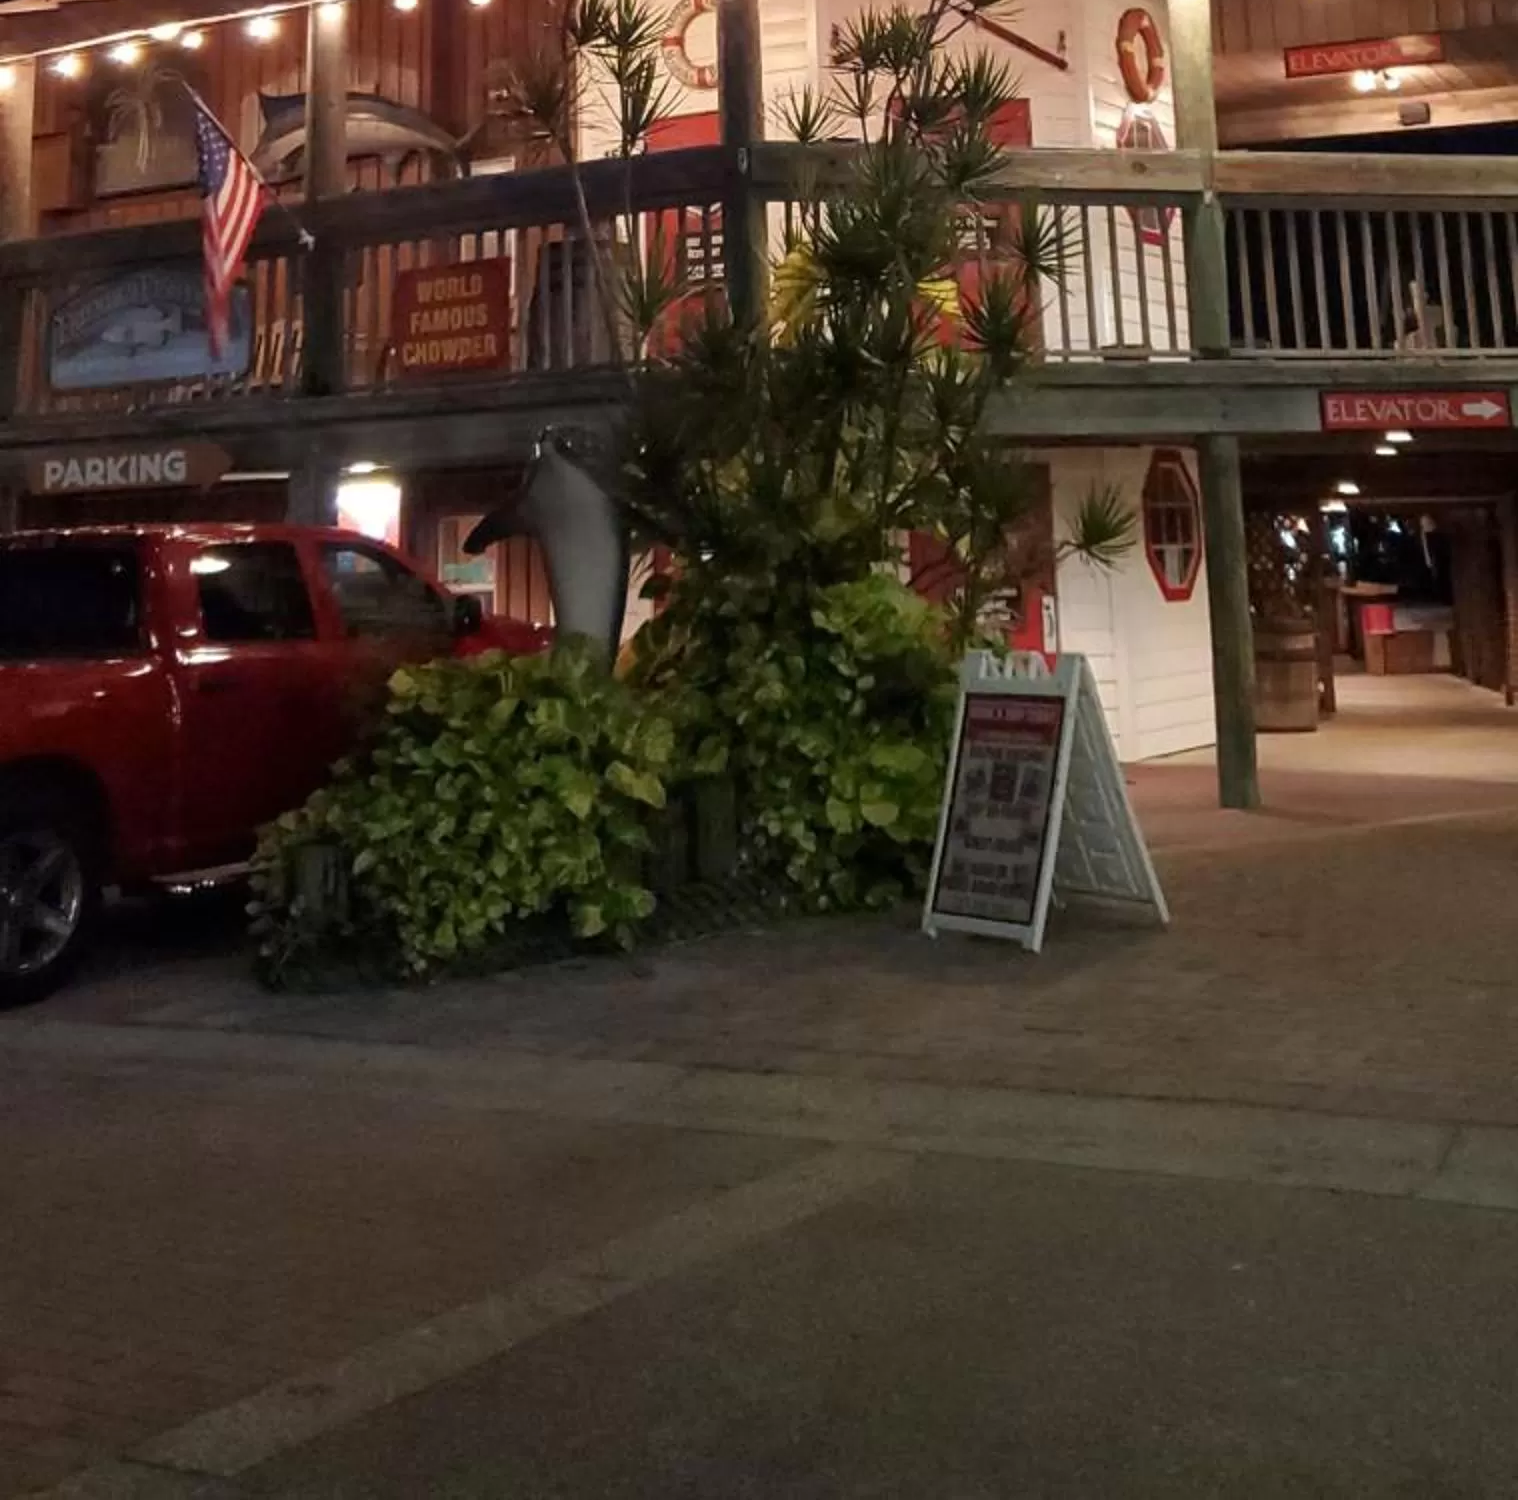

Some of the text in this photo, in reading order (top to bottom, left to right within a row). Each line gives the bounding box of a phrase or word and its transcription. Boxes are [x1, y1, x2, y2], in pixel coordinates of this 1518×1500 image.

[418, 274, 482, 302] WORLD
[411, 304, 487, 334] FAMOUS
[403, 334, 496, 365] CHOWDER
[1327, 399, 1459, 421] ELEVATOR
[45, 451, 187, 489] PARKING
